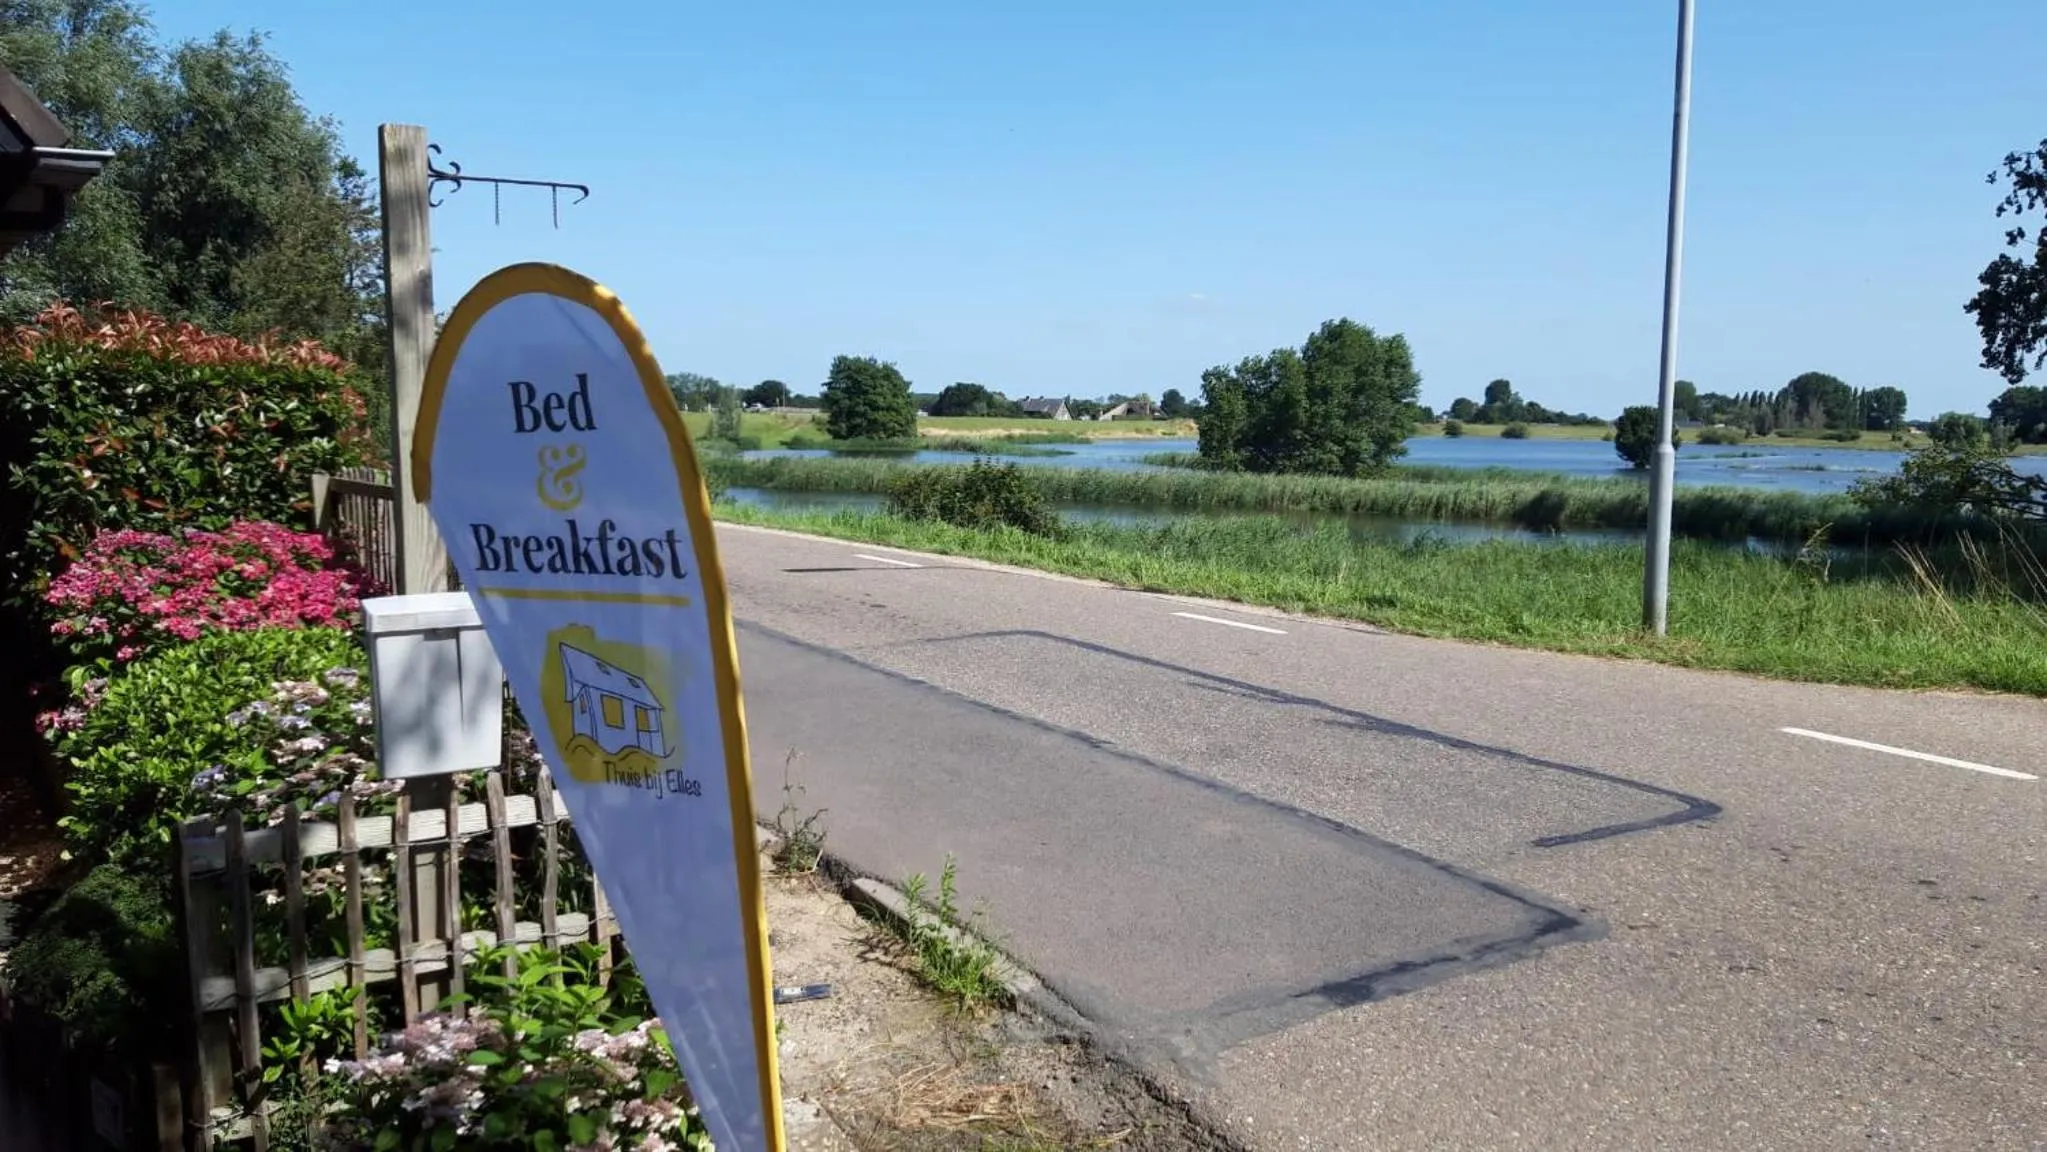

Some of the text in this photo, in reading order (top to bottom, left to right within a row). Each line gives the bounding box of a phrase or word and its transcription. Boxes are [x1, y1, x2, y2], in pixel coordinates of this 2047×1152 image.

[508, 373, 598, 433] Bed
[536, 444, 587, 512] &
[469, 519, 688, 579] Breakfast
[603, 760, 702, 799] Thuis bij Elles
